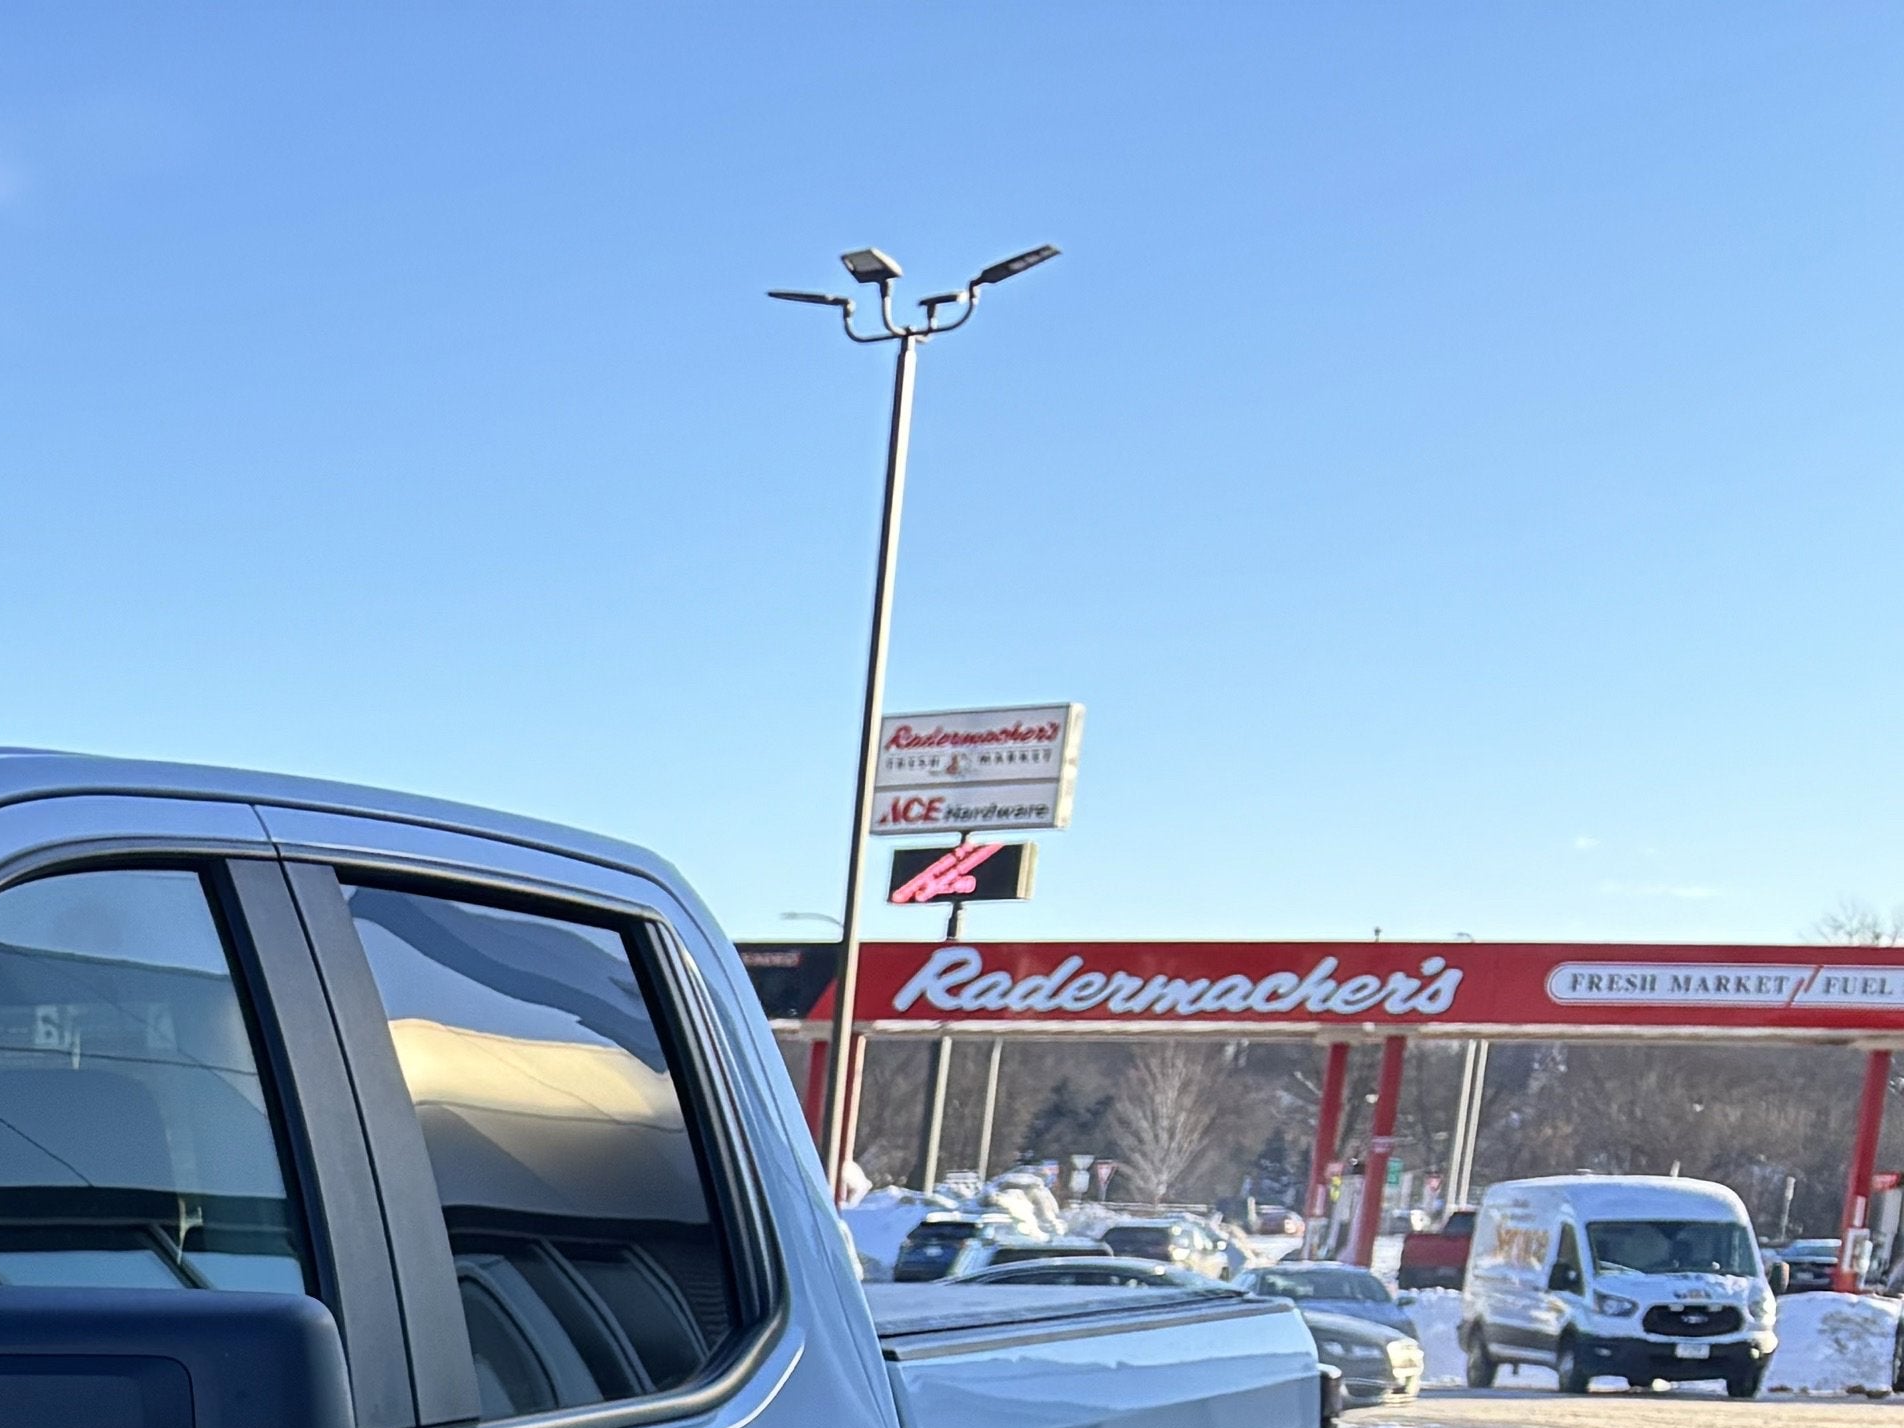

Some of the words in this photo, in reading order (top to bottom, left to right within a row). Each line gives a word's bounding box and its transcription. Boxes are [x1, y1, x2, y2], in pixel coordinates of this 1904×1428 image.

[880, 796, 946, 825] ACE
[894, 946, 1464, 1016] Radermacher's
[1570, 973, 1659, 993] FRESH
[1669, 974, 1792, 995] MARKET
[1823, 976, 1894, 996] FUEL
